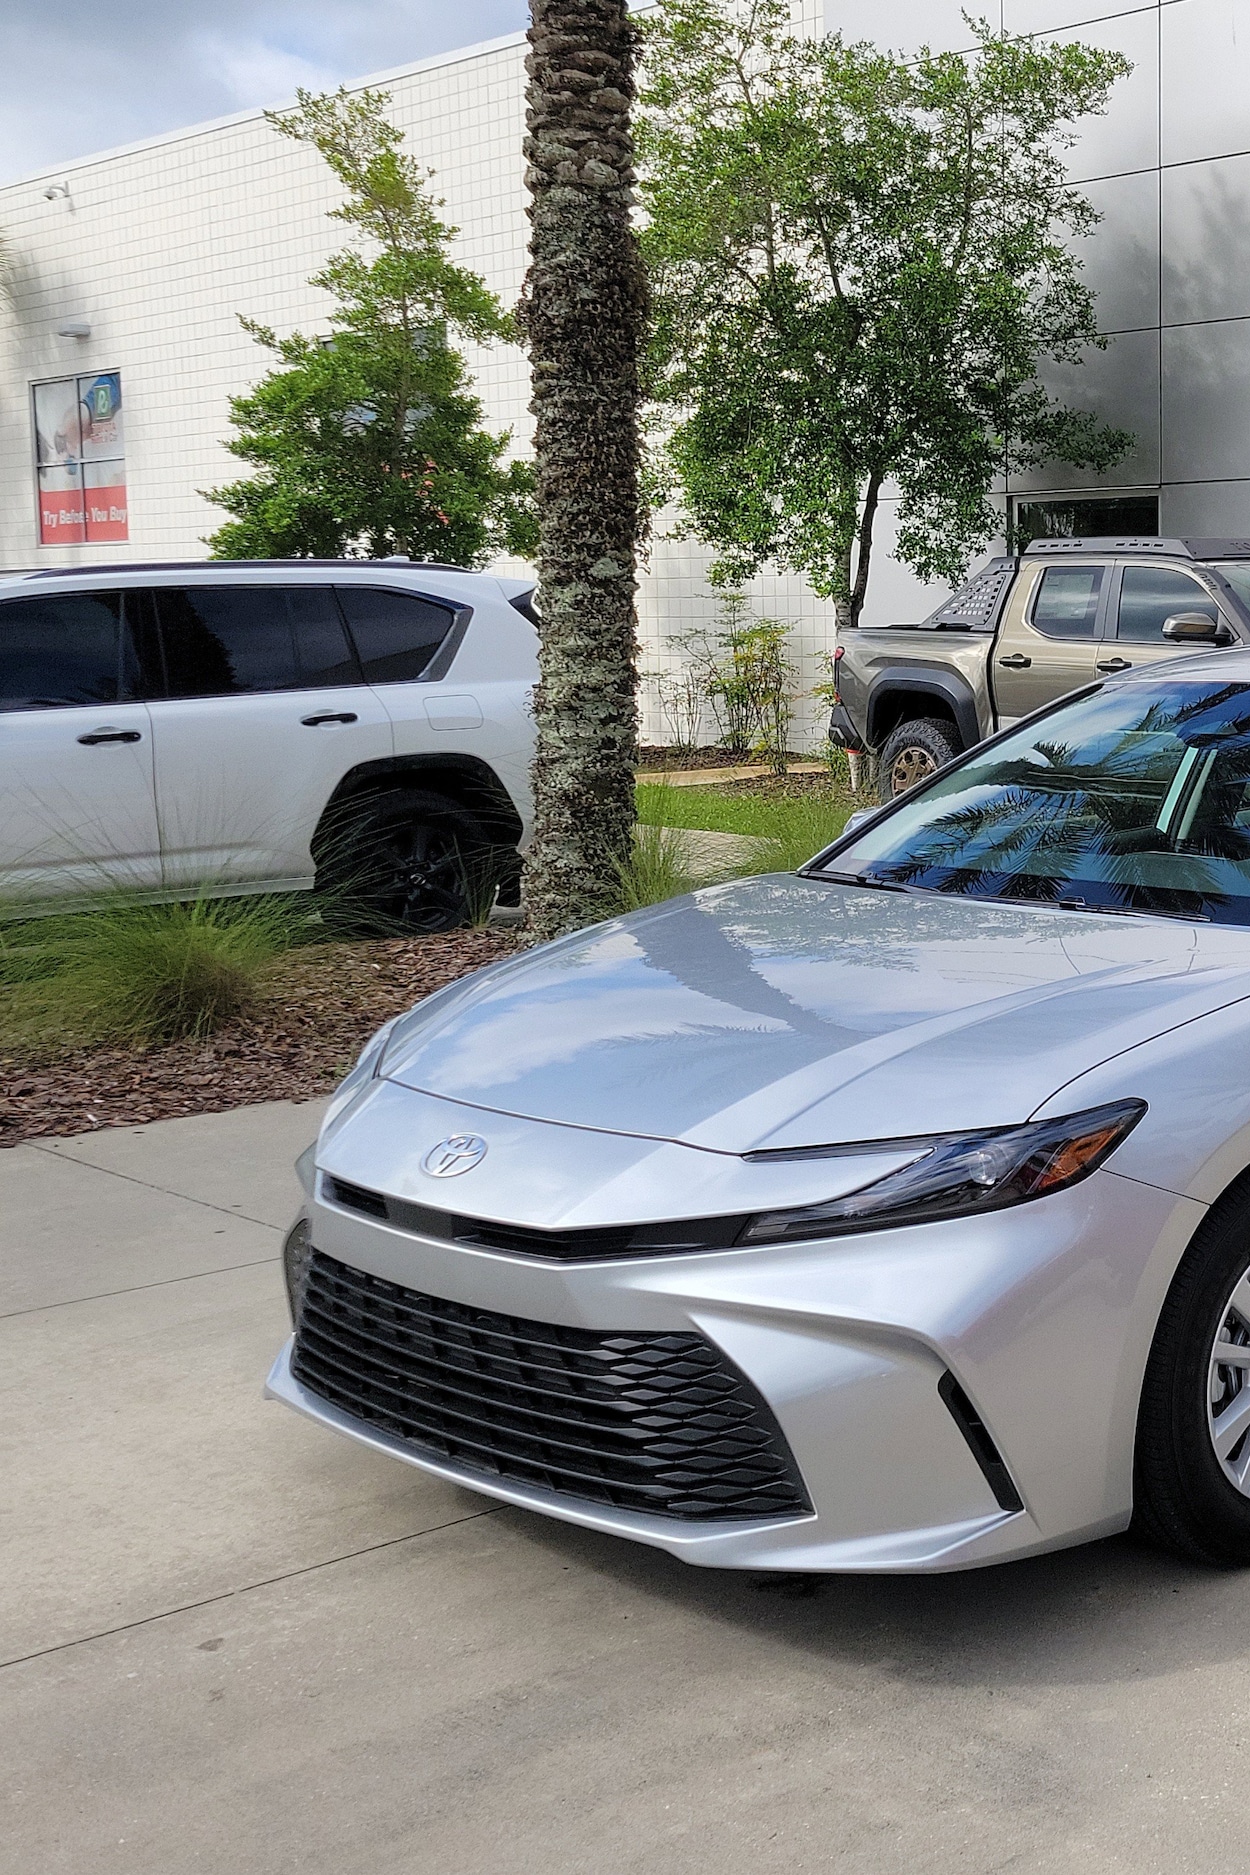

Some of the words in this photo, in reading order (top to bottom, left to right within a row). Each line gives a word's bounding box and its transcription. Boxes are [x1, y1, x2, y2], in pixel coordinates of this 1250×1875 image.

[43, 511, 58, 528] Try
[91, 507, 108, 522] You
[109, 505, 128, 524] Buy
